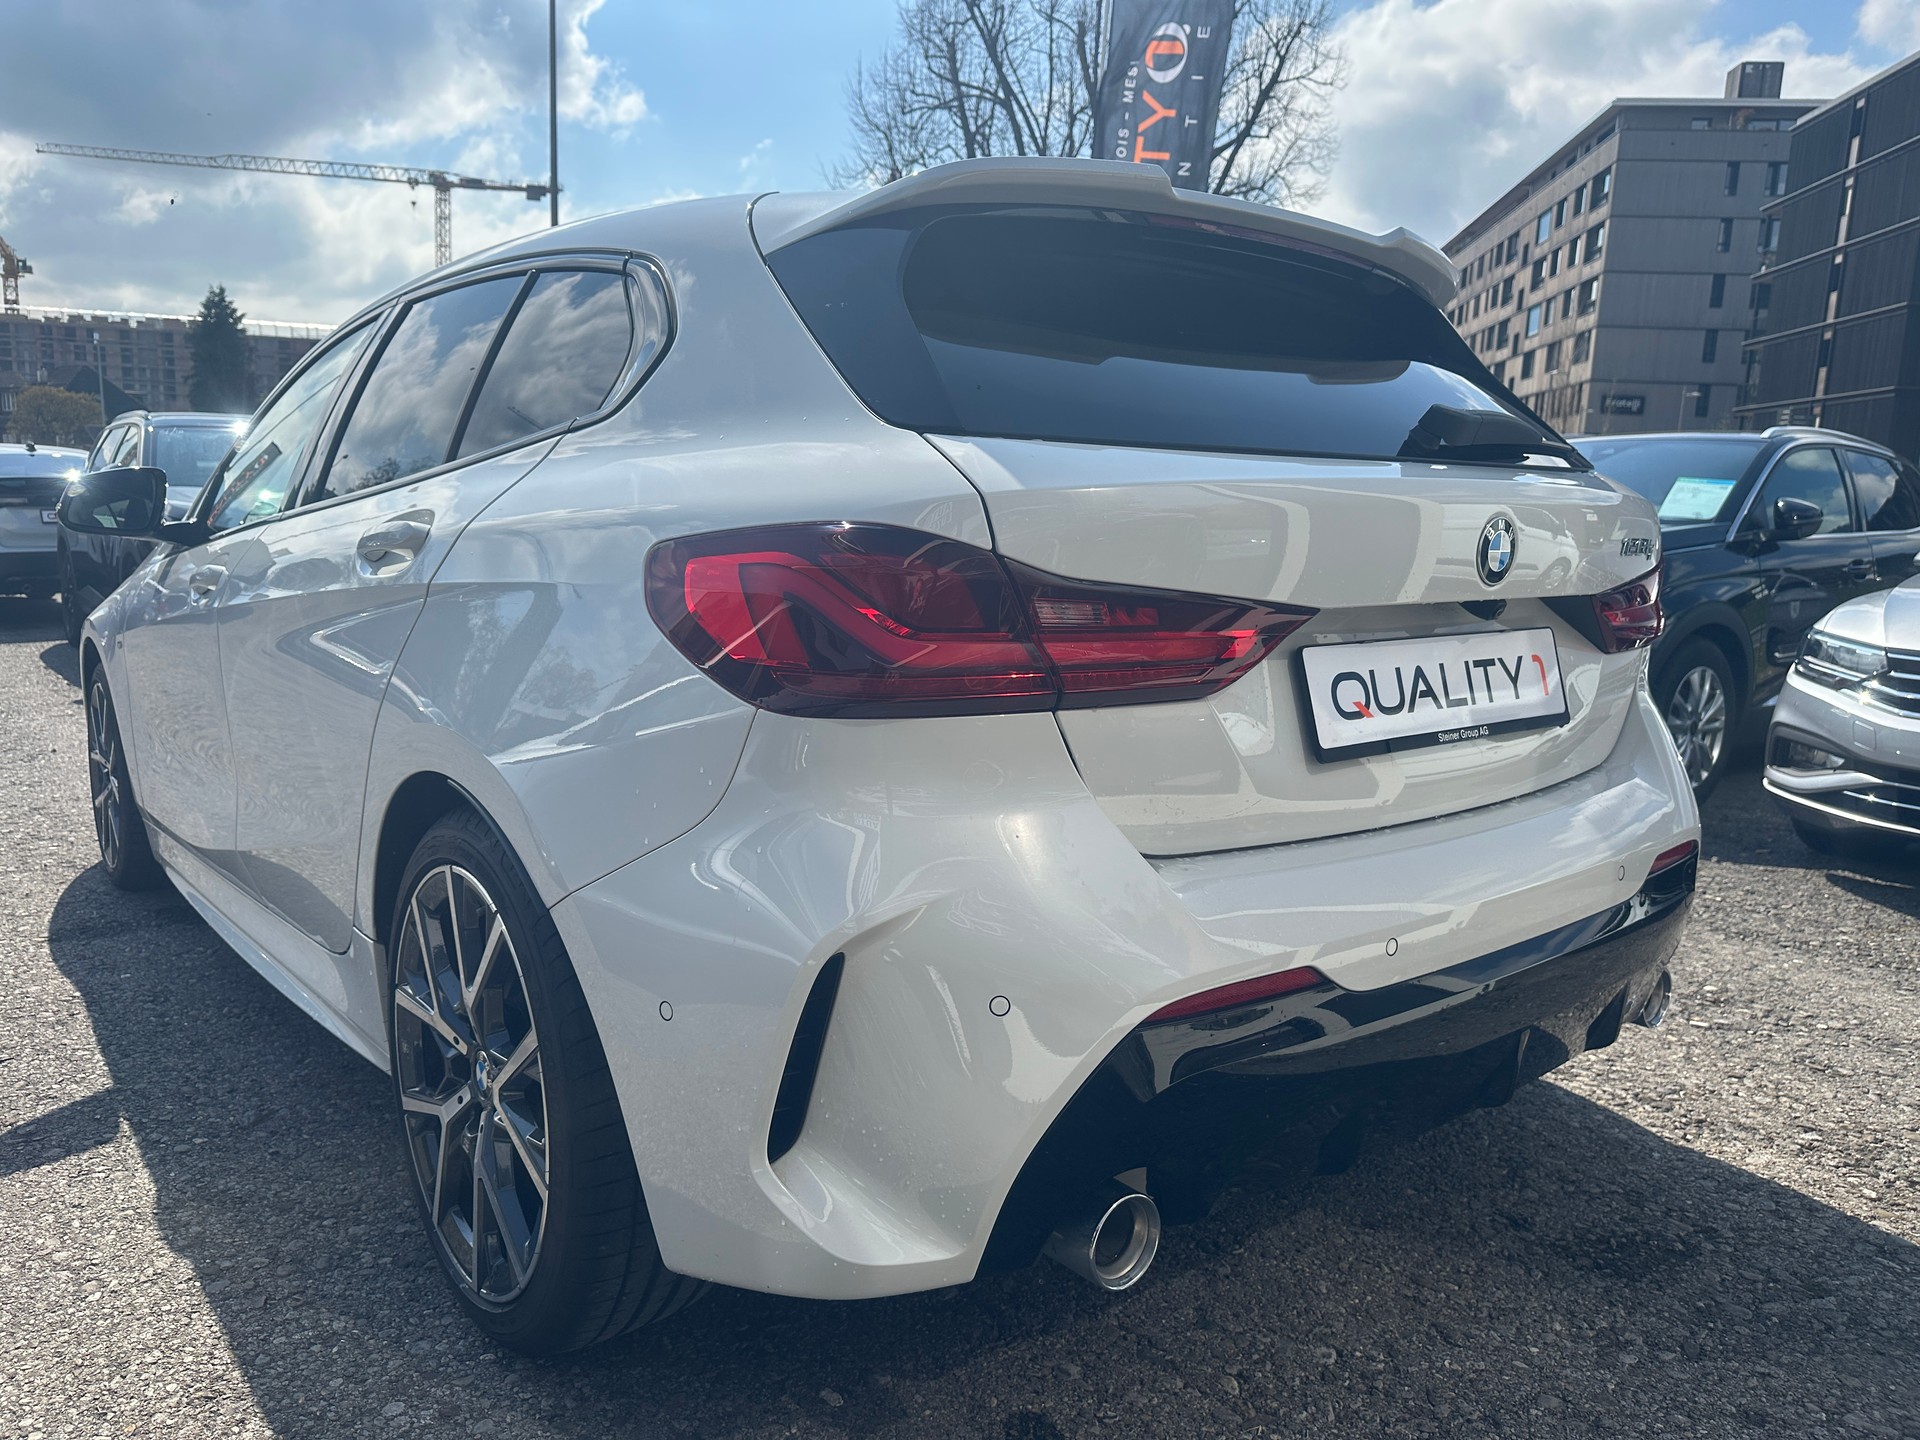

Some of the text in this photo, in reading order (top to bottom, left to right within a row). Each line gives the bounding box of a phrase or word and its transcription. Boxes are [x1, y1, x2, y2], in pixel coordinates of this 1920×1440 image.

[1486, 519, 1515, 541] BMW
[1437, 725, 1489, 742] Steiner Group AG
